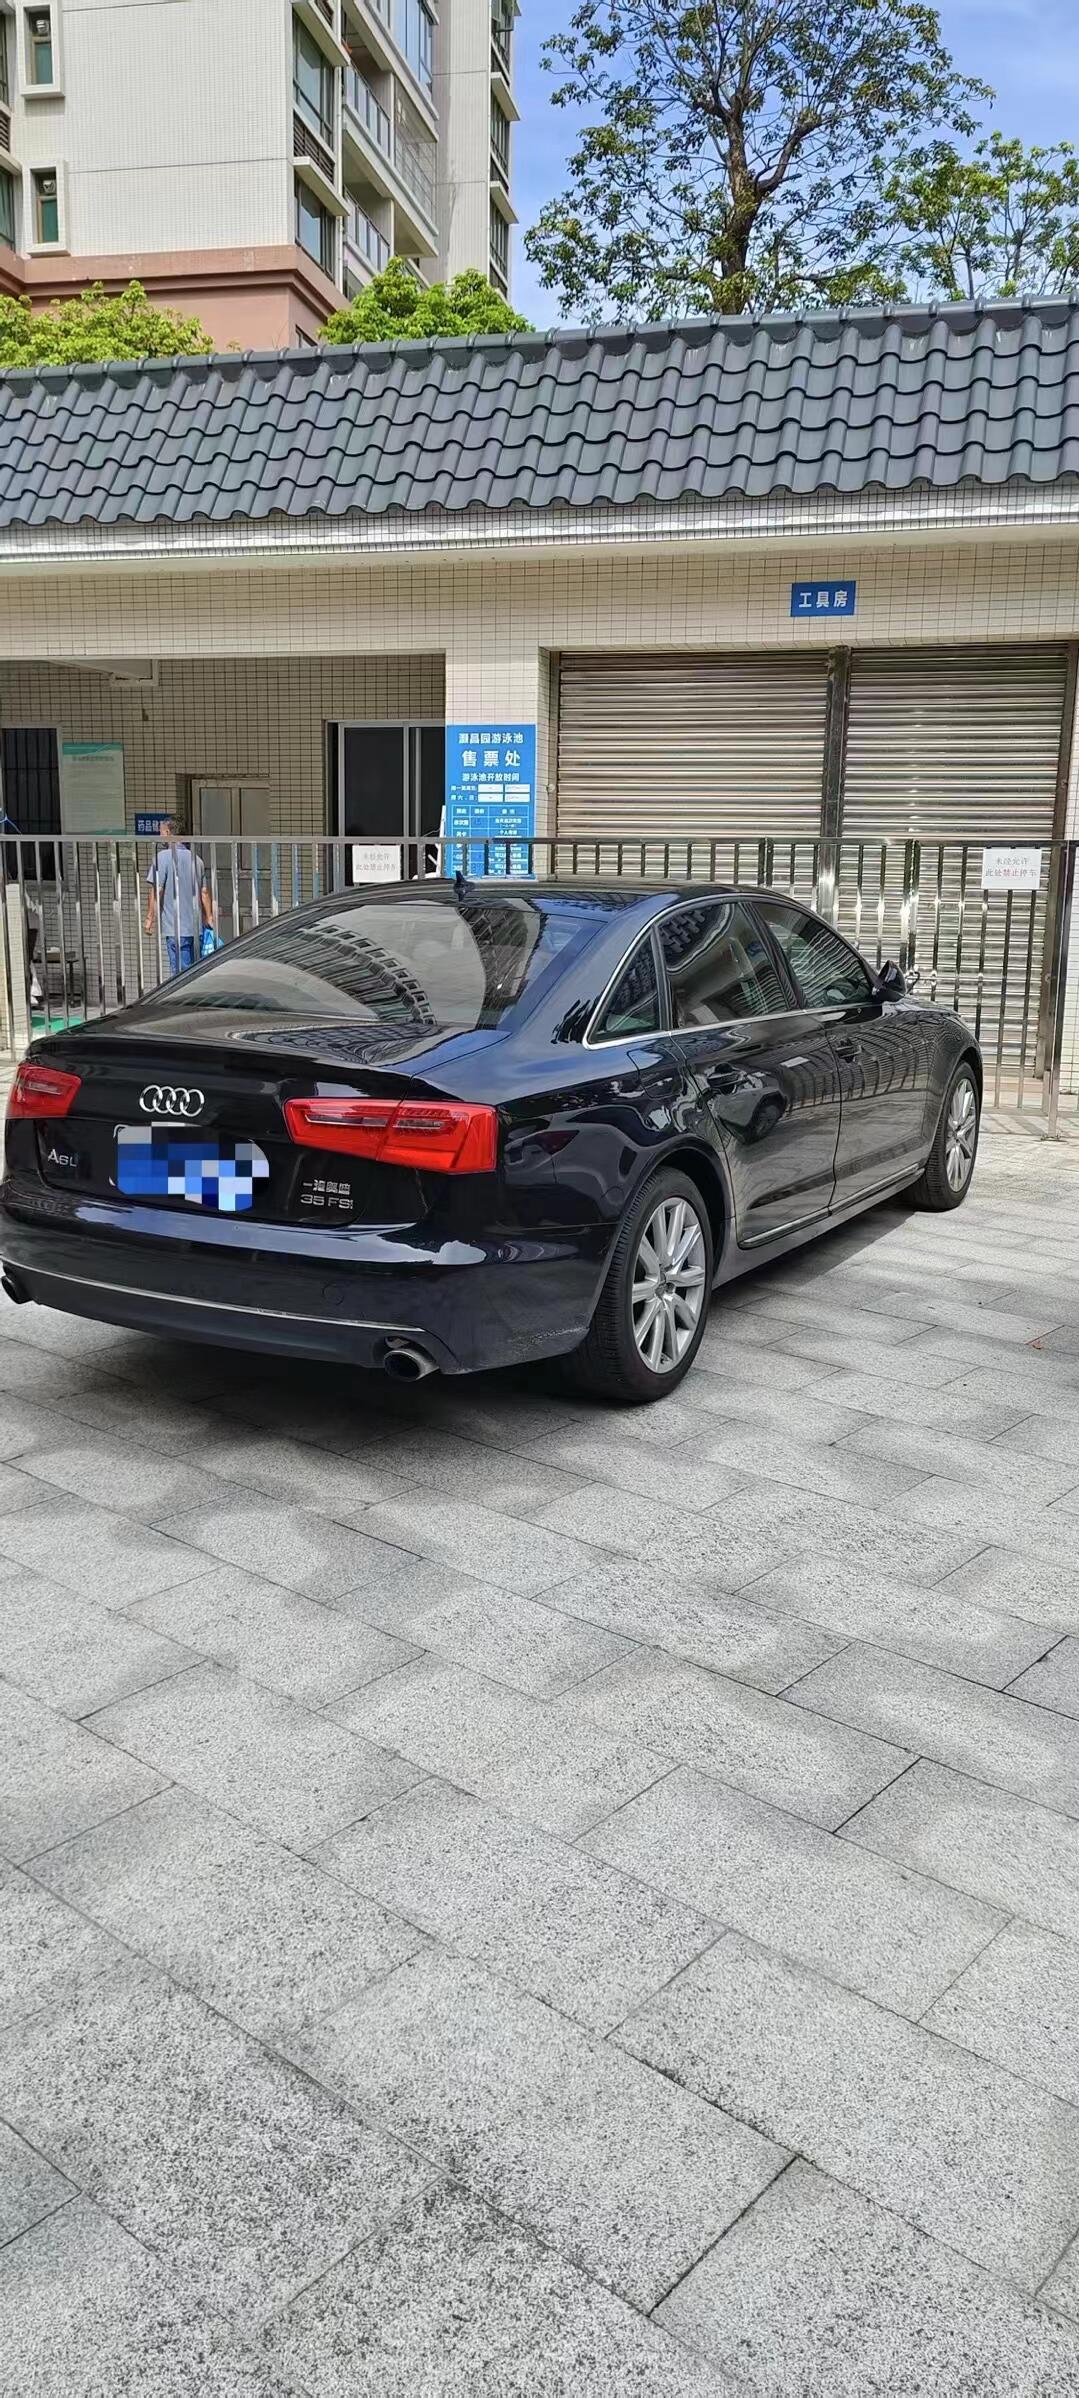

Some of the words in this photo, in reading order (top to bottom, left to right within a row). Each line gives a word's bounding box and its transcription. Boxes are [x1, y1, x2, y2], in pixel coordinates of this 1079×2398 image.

[798, 590, 848, 608] 工具房
[462, 750, 521, 767] 售票处
[462, 773, 520, 782] 游泳池开放时间
[137, 819, 163, 832] 药品储
[47, 1148, 77, 1168] A6L
[300, 1193, 325, 1206] 35
[327, 1196, 354, 1210] FSI
